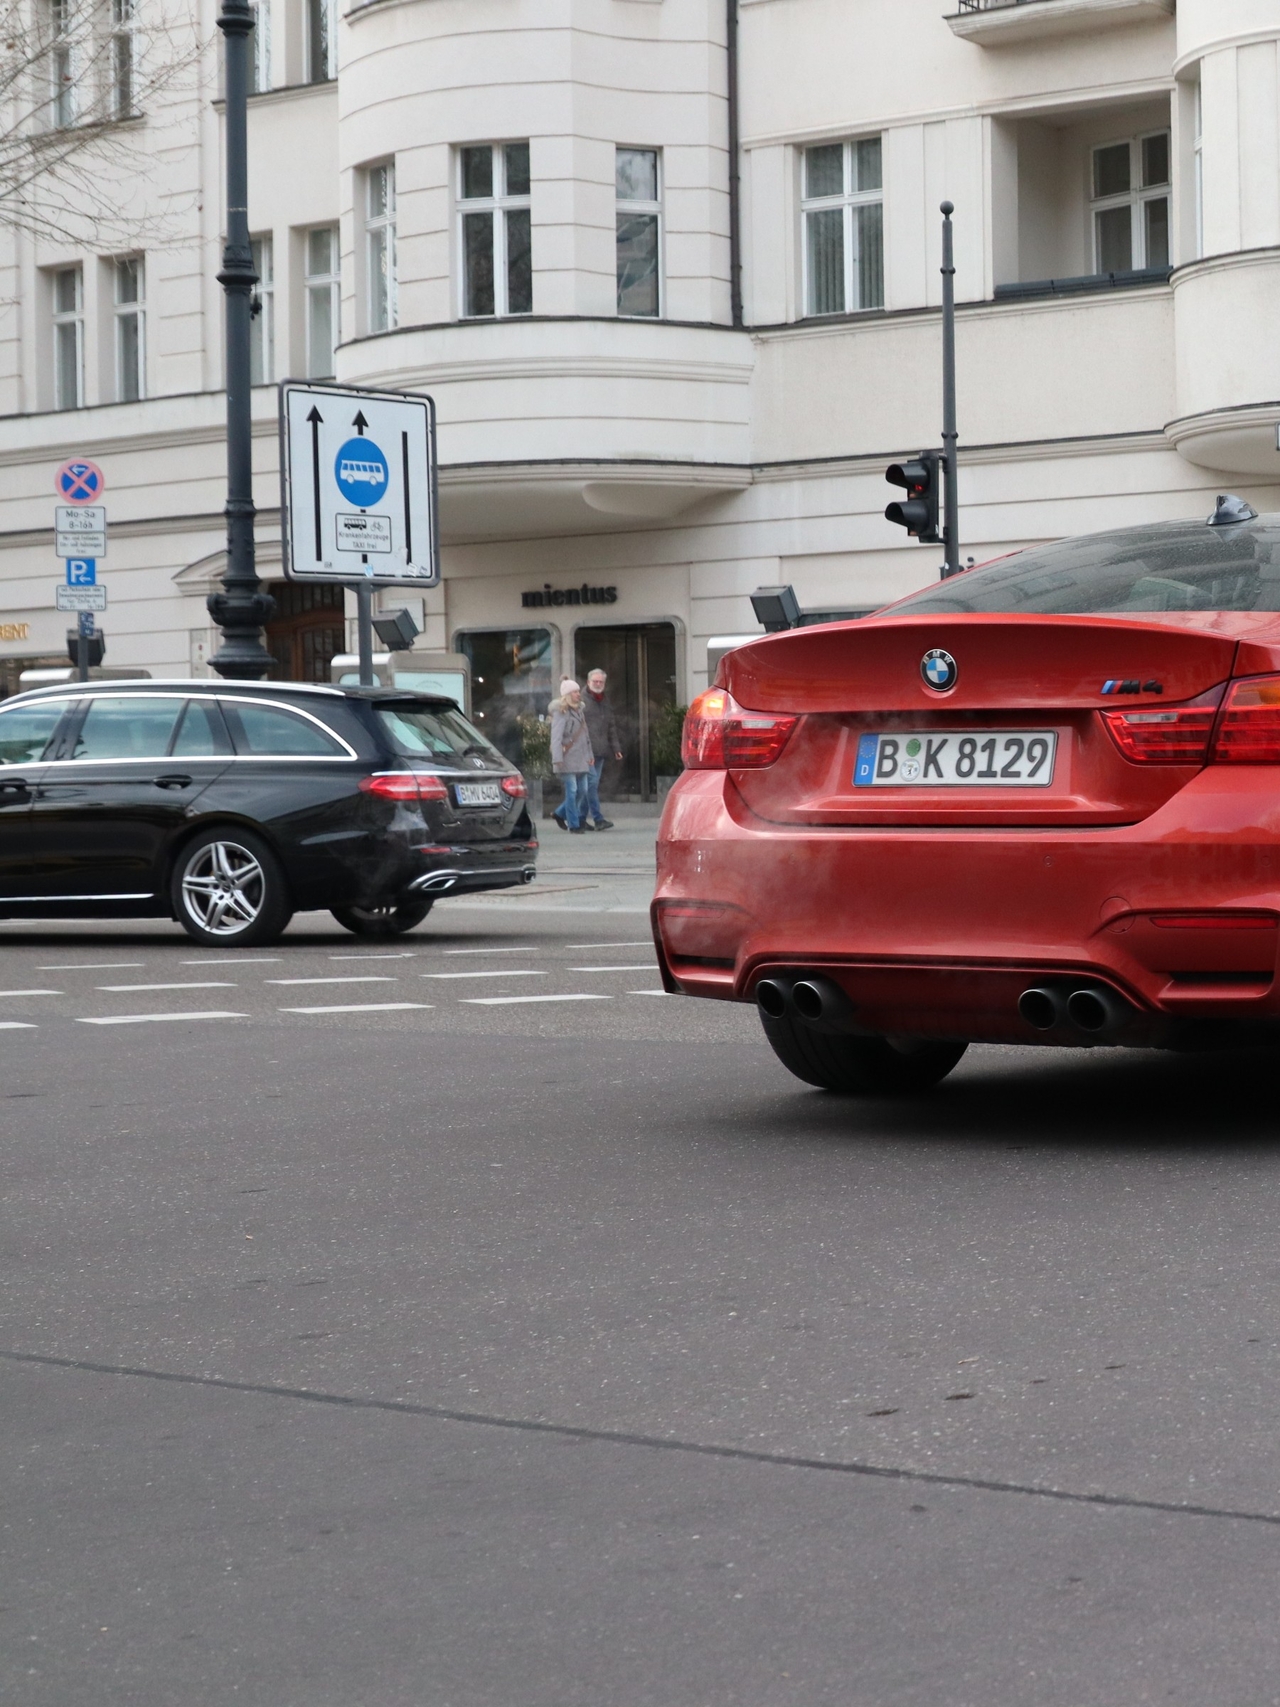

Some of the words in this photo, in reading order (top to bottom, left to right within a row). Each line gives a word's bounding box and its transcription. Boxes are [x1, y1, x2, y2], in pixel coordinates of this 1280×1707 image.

[70, 560, 88, 584] P
[521, 583, 618, 608] mientus
[923, 650, 952, 664] BMW
[1117, 679, 1163, 695] M4
[860, 764, 869, 776] D
[955, 737, 1049, 778] 8129
